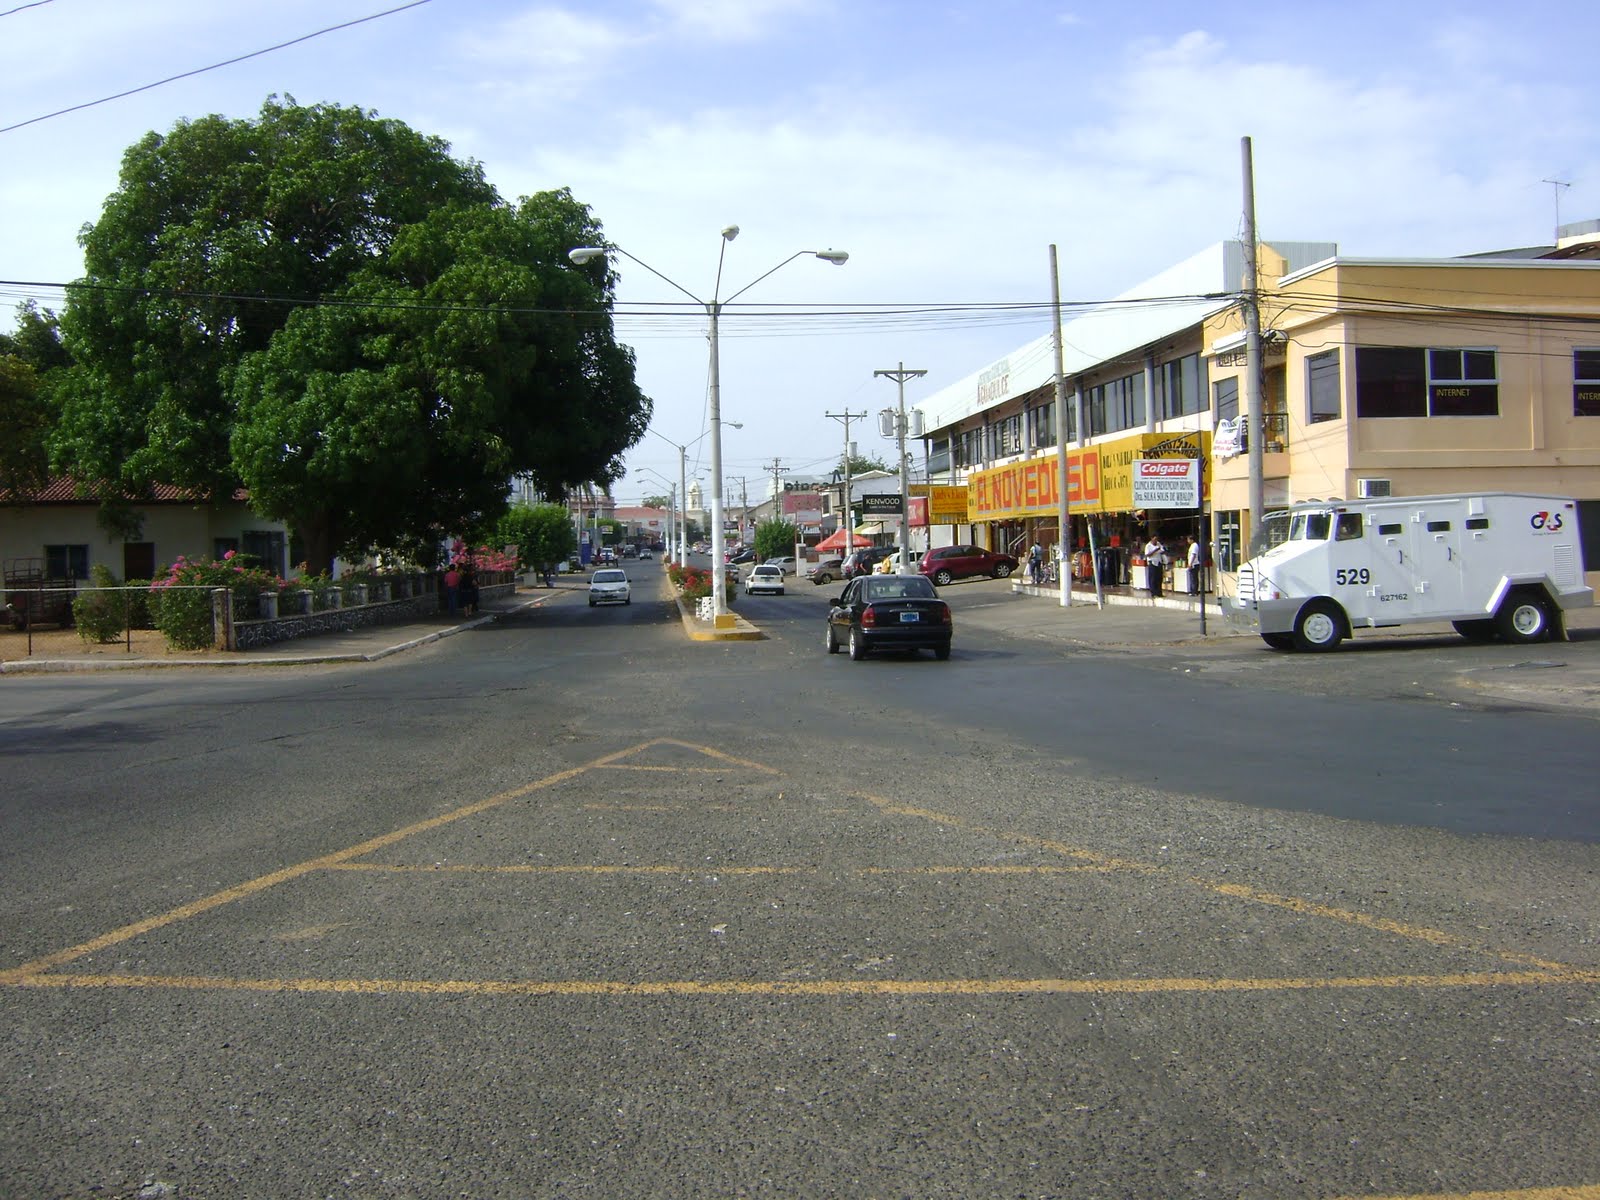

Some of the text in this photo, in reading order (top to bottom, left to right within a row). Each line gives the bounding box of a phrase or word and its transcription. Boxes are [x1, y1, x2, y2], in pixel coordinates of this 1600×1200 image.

[1436, 388, 1471, 397] INTERNET
[1141, 463, 1188, 475] Colgate
[1336, 568, 1370, 585] 529
[1380, 593, 1408, 602] 627162
